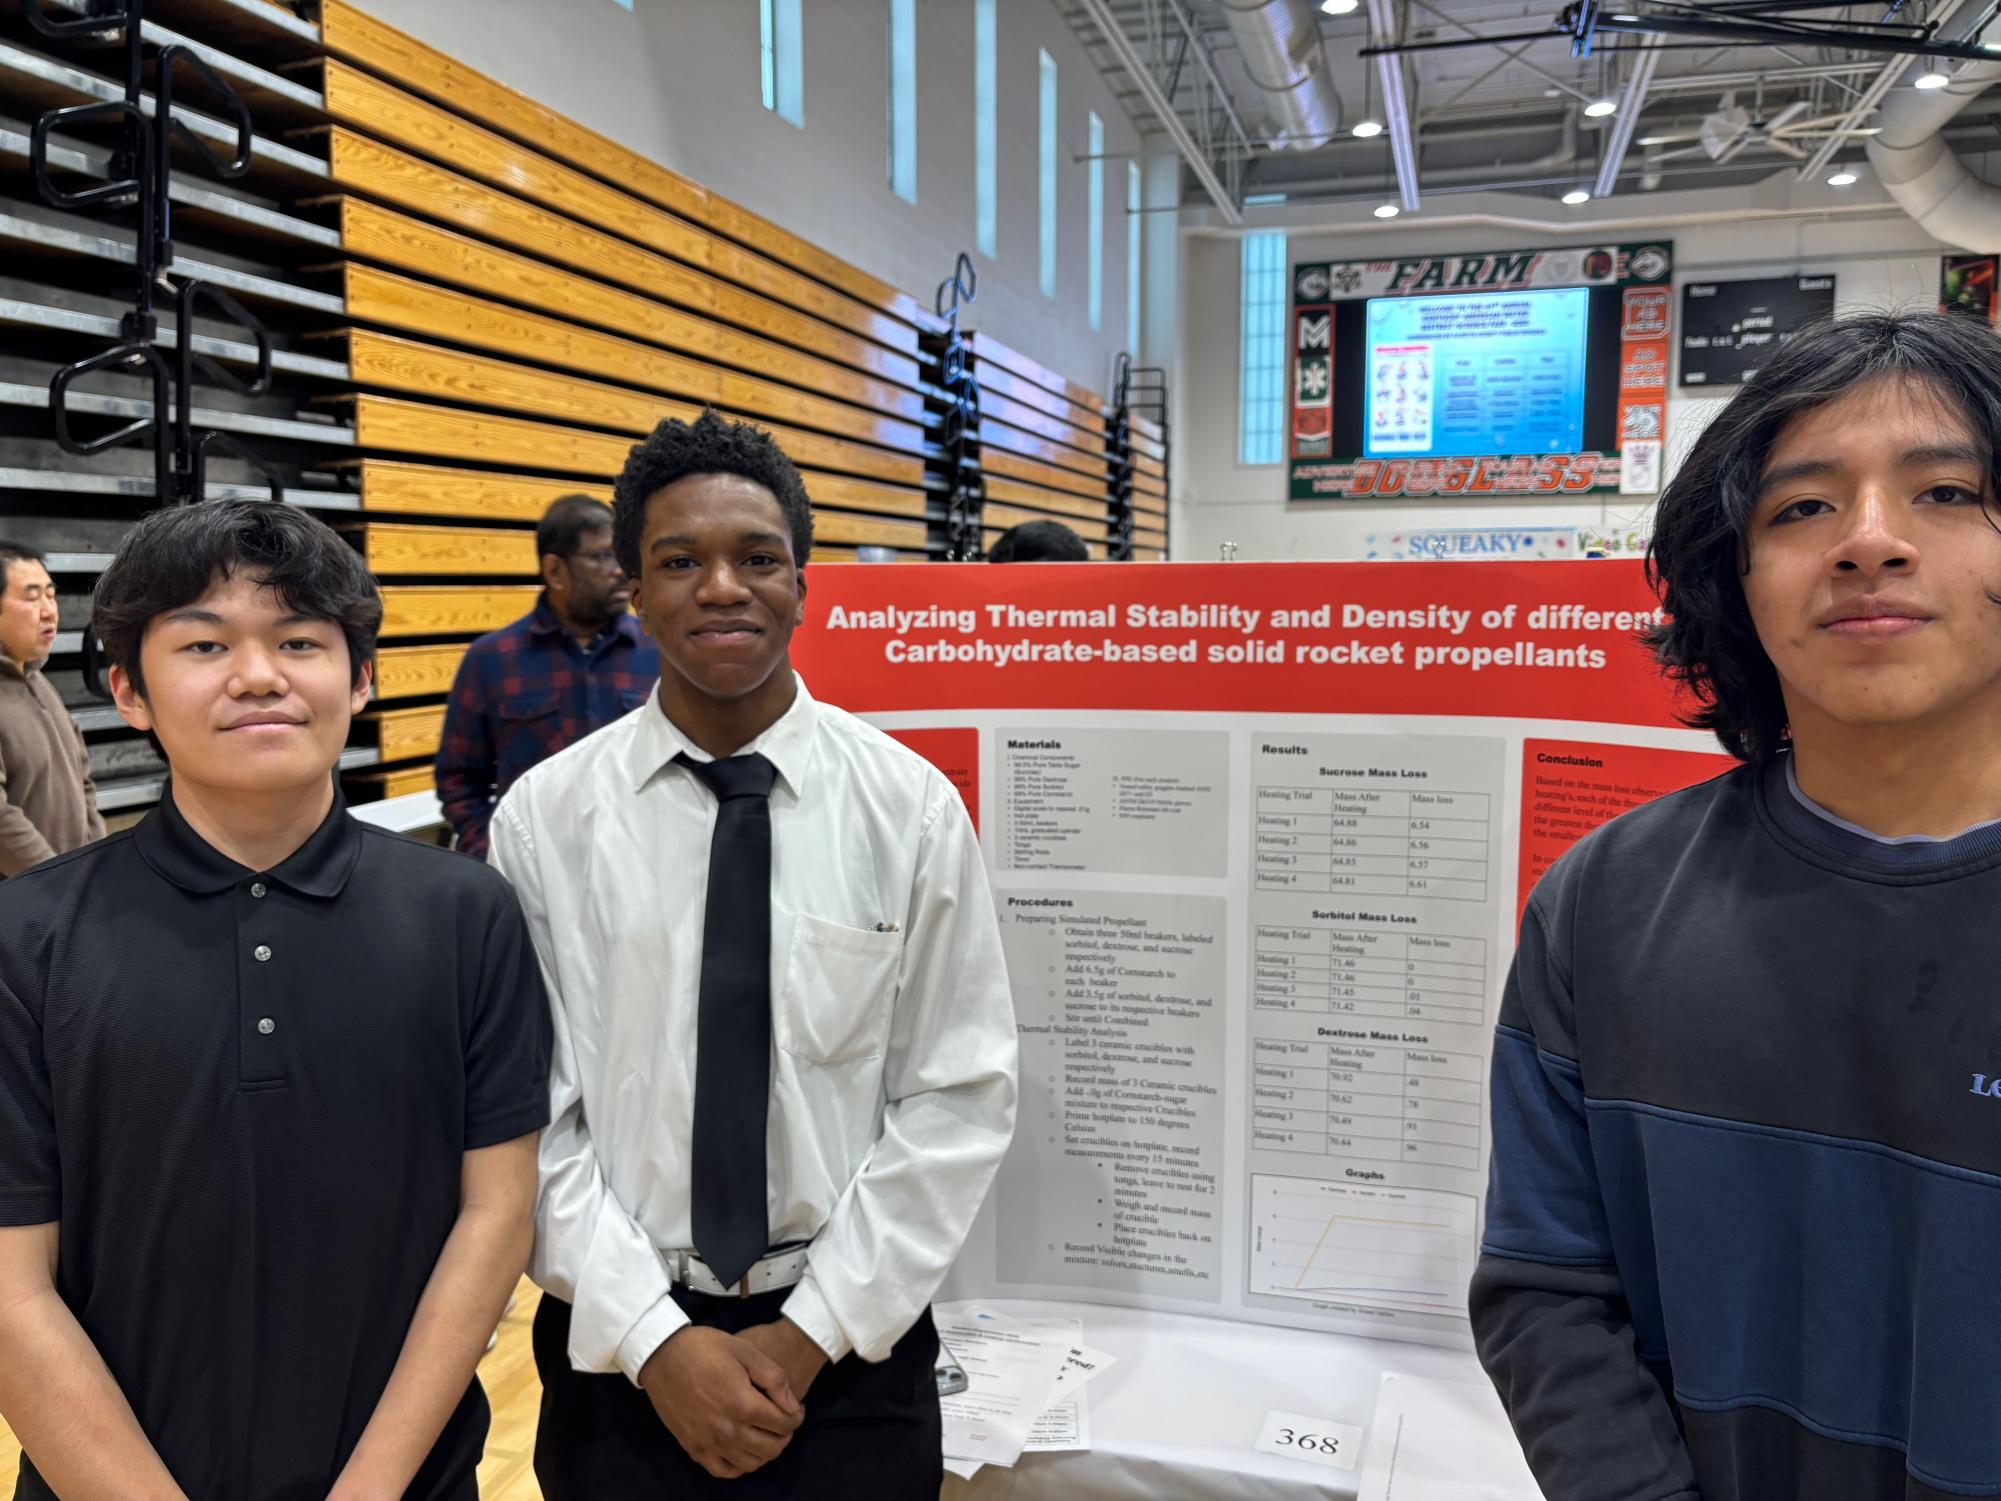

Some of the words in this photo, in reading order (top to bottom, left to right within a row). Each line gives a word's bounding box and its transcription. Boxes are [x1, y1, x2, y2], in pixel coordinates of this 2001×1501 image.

[1385, 254, 1539, 291] FARM
[1342, 453, 1603, 496] DOUGLASS
[1409, 534, 1523, 555] SQUEAKY
[1577, 534, 1620, 551] Video
[826, 604, 976, 633] Analyzing
[985, 604, 1116, 628] Thermal
[1126, 604, 1260, 633] Stability
[1270, 604, 1330, 628] and
[1342, 604, 1471, 634] Density
[1481, 604, 1517, 628] of
[884, 639, 1197, 667] Carbohydrate-based
[1207, 639, 1284, 665] solid
[1296, 640, 1404, 665] rocket
[1414, 641, 1607, 670] propellants
[1008, 740, 1062, 749] Materials
[1262, 744, 1308, 755] Results
[1537, 753, 1603, 768] Conclusion
[1319, 767, 1365, 777] Sucrose
[1368, 768, 1397, 777] Mass
[1401, 769, 1428, 778] Loss
[1536, 776, 1562, 786] Based
[1577, 780, 1590, 789] the
[1592, 783, 1612, 791] mass
[1614, 784, 1630, 794] loss
[1259, 790, 1291, 800] Heating
[1294, 791, 1312, 800] Trial
[1335, 792, 1357, 801] Mass
[1359, 793, 1380, 802] After
[1412, 794, 1434, 803] Mass
[1437, 794, 1454, 804] loss
[1334, 804, 1367, 814] Heating
[1259, 816, 1291, 827] Heating
[1258, 835, 1291, 846] Heating
[1258, 854, 1290, 865] Heating
[1258, 873, 1290, 884] Heating
[1291, 874, 1297, 883] 4
[1008, 898, 1073, 907] Procedures
[1016, 914, 1056, 925] Preparing
[1059, 915, 1100, 925] Simulated
[1103, 917, 1147, 927] Propellant
[1312, 910, 1355, 921] Sorbitol
[1359, 912, 1388, 922] Mass
[1391, 914, 1417, 924] Loss
[1065, 928, 1094, 937] Obtain
[1097, 929, 1117, 937] three
[1182, 934, 1213, 943] labeled
[1257, 929, 1289, 940] Heating
[1292, 930, 1311, 940] Trial
[1333, 932, 1354, 941] Mass
[1356, 934, 1378, 943] After
[1409, 936, 1432, 947] Mass
[1144, 944, 1159, 953] and
[1161, 946, 1194, 955] sucrose
[1332, 944, 1365, 955] Heating
[1065, 953, 1116, 964] respectively
[1257, 954, 1290, 965] Heating
[1065, 965, 1084, 973] Add
[1107, 966, 1116, 974] of
[1118, 967, 1165, 978] Cornstarch
[1167, 971, 1176, 979] to
[1257, 969, 1289, 979] Heating
[1065, 978, 1085, 986] each
[1089, 979, 1118, 987] beaker
[1256, 983, 1289, 994] Heating
[1065, 990, 1084, 998] Add
[1107, 991, 1117, 999] of
[1196, 997, 1212, 1007] and
[1256, 998, 1288, 1008] Heating
[1065, 1002, 1097, 1011] sucrose
[1100, 1003, 1109, 1011] to
[1110, 1004, 1120, 1012] its
[1122, 1005, 1165, 1016] respective
[1167, 1007, 1200, 1018] beakers
[1065, 1014, 1081, 1022] Stir
[1083, 1015, 1102, 1023] until
[1104, 1016, 1149, 1026] Combined
[1017, 1024, 1051, 1034] Thermal
[1054, 1026, 1088, 1036] Stability
[1091, 1028, 1128, 1037] Analysis
[1318, 1027, 1367, 1039] Dextrose
[1370, 1031, 1399, 1041] Mass
[1402, 1032, 1428, 1043] Loss
[1065, 1039, 1090, 1048] Label
[1099, 1040, 1133, 1050] ceramic
[1175, 1046, 1195, 1055] with
[1256, 1041, 1288, 1053] Heating
[1291, 1044, 1309, 1053] Trial
[1331, 1047, 1352, 1057] Mass
[1354, 1049, 1375, 1058] After
[1407, 1052, 1429, 1062] Mass
[1330, 1058, 1363, 1070] Heating
[1256, 1067, 1288, 1078] Heating
[1255, 1088, 1289, 1100] Heating
[1255, 1109, 1287, 1121] Heating
[1255, 1130, 1286, 1142] Heating
[1345, 1168, 1385, 1180] Graphs
[1274, 1428, 1340, 1456] 368
